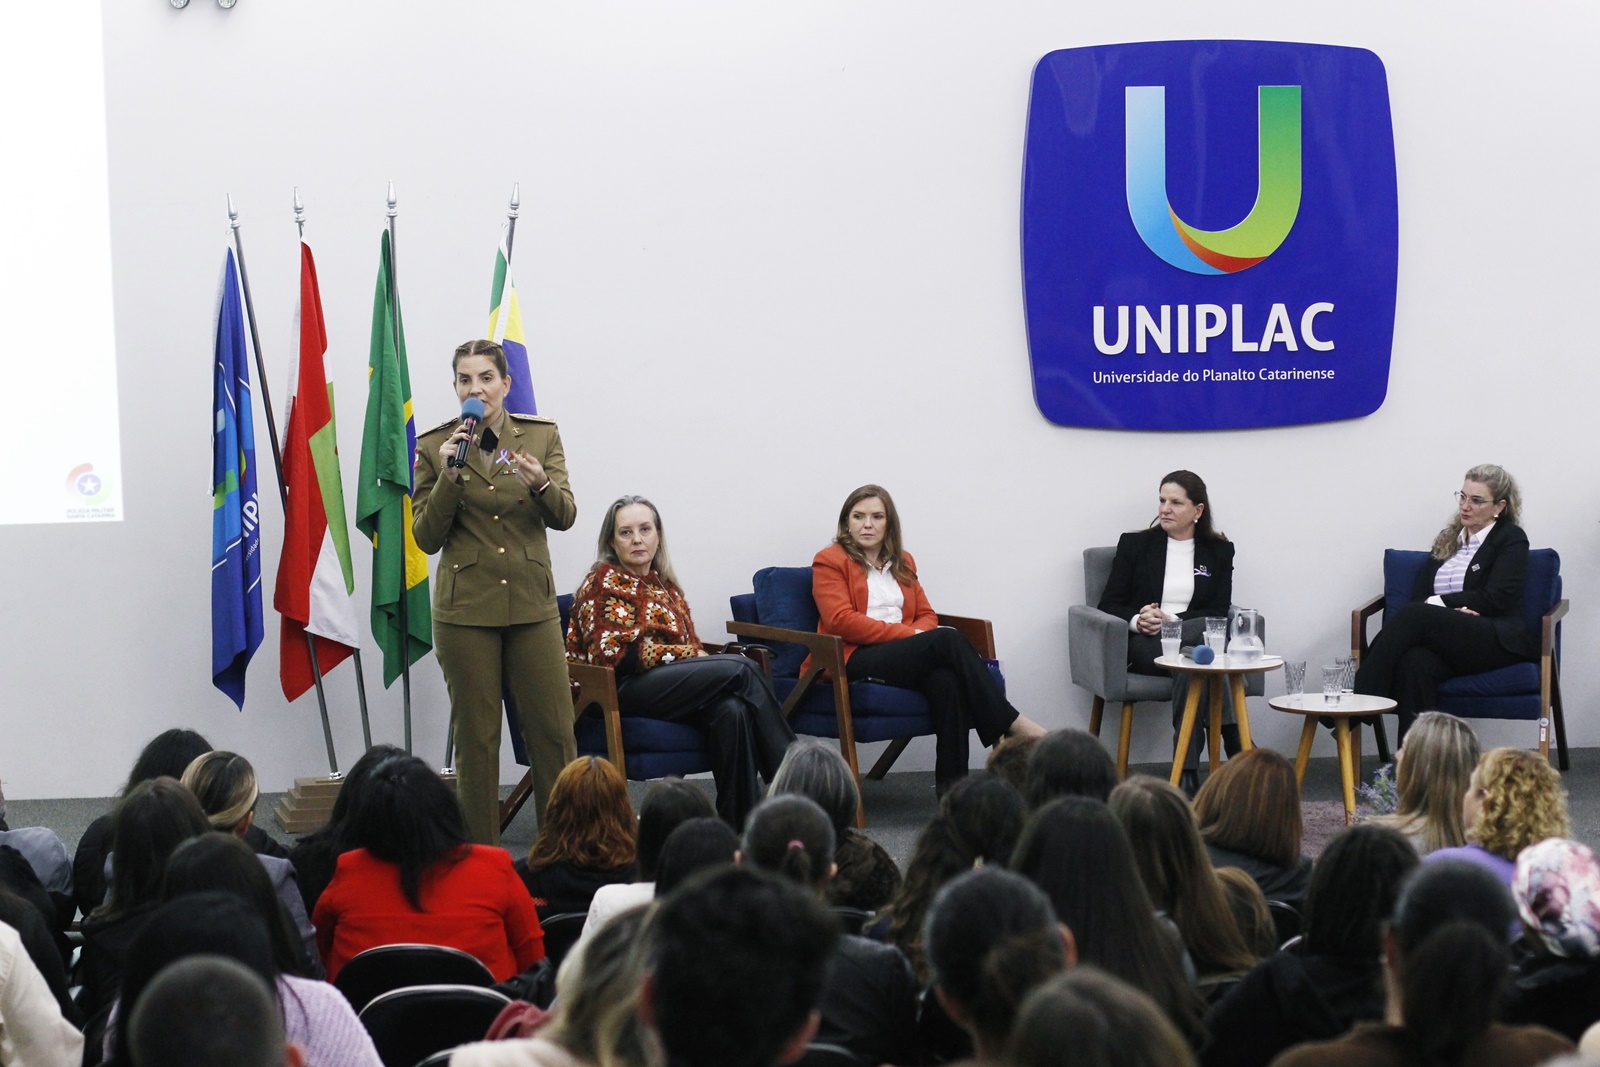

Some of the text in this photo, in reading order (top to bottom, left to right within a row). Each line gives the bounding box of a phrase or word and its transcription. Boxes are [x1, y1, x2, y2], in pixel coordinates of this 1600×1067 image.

[1093, 302, 1335, 355] UNIPLAC
[1093, 367, 1335, 383] Universidade do Planalto Catarinense
